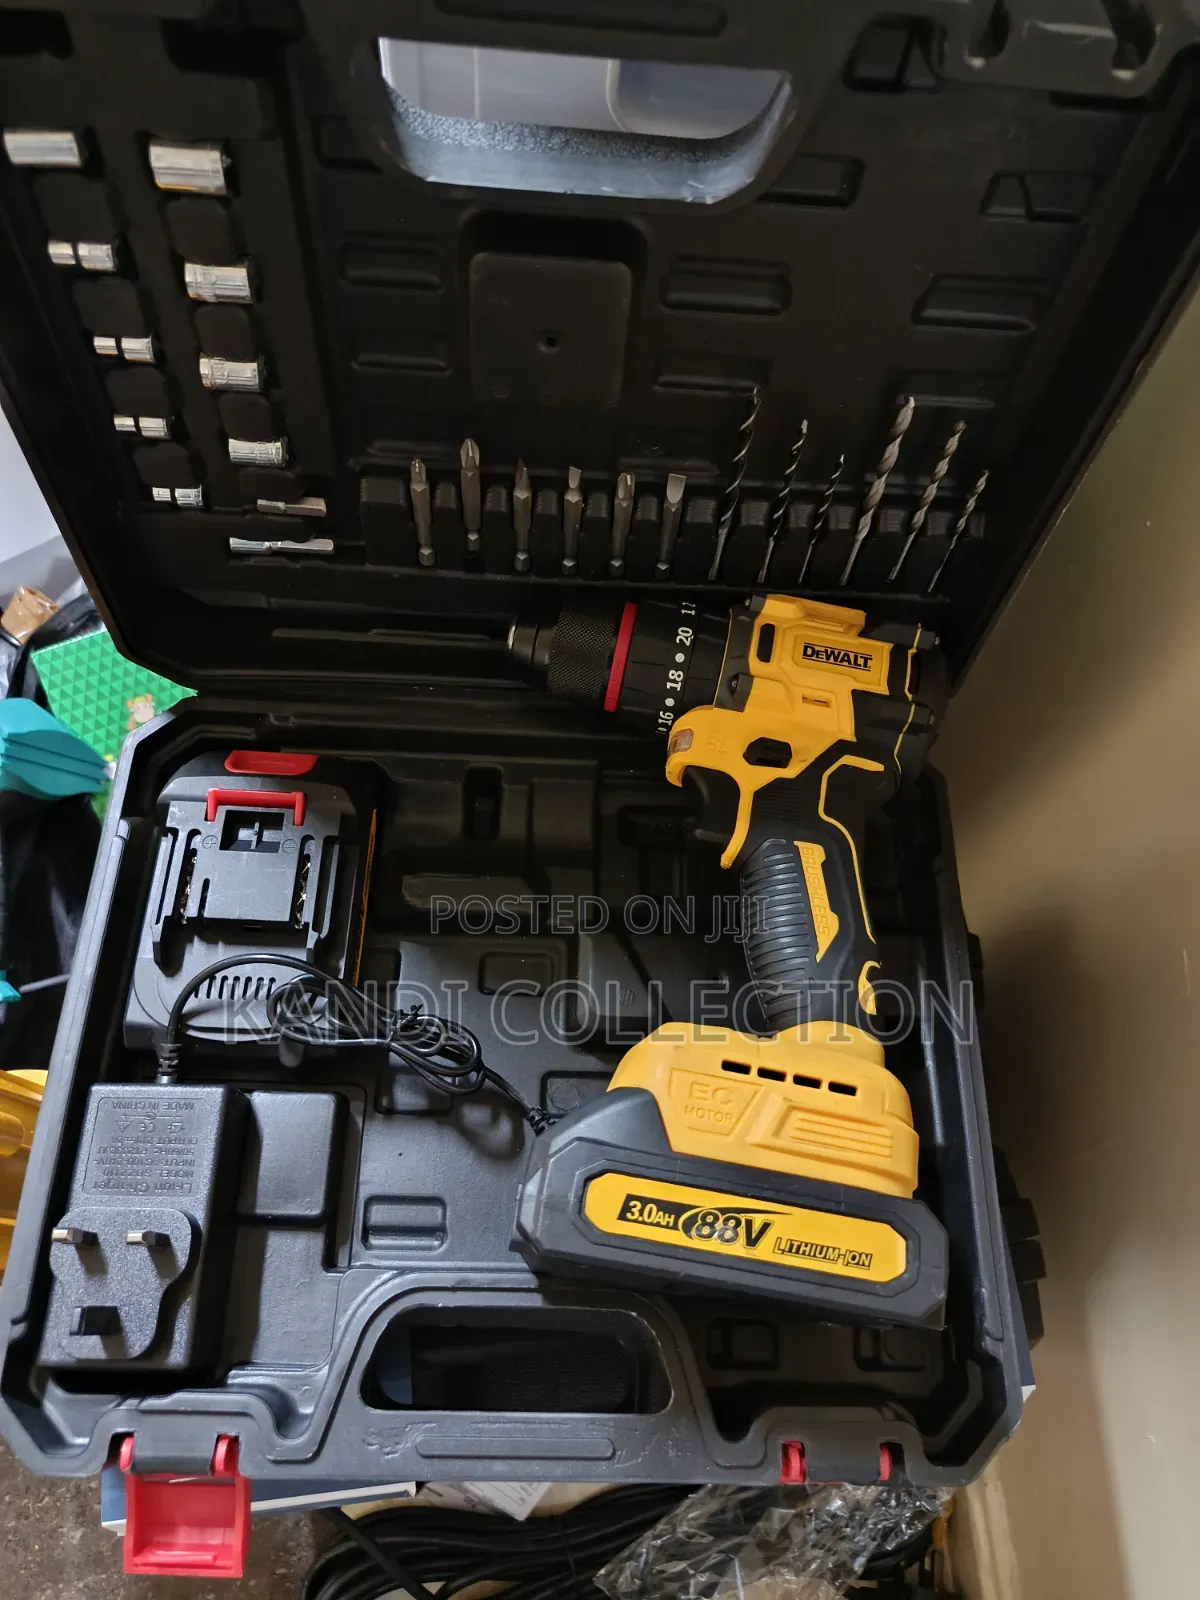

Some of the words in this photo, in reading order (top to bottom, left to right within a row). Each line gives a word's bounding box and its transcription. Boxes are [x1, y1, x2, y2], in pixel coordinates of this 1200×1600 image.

[658, 711, 674, 726] 16
[666, 669, 684, 691] 18
[676, 627, 693, 646] 20
[802, 846, 832, 935] BRUSHLESS
[689, 1081, 734, 1105] EC
[112, 1101, 145, 1110] CHINA
[149, 1101, 160, 1110] IN
[162, 1101, 195, 1111] MADE
[684, 1104, 734, 1124] MOTOR
[92, 1179, 150, 1194] Charger
[154, 1182, 192, 1193] Li-ion
[626, 1200, 675, 1227] 3.0AH
[692, 1209, 774, 1250] 88V
[774, 1237, 872, 1270] LITHIUM-ION
